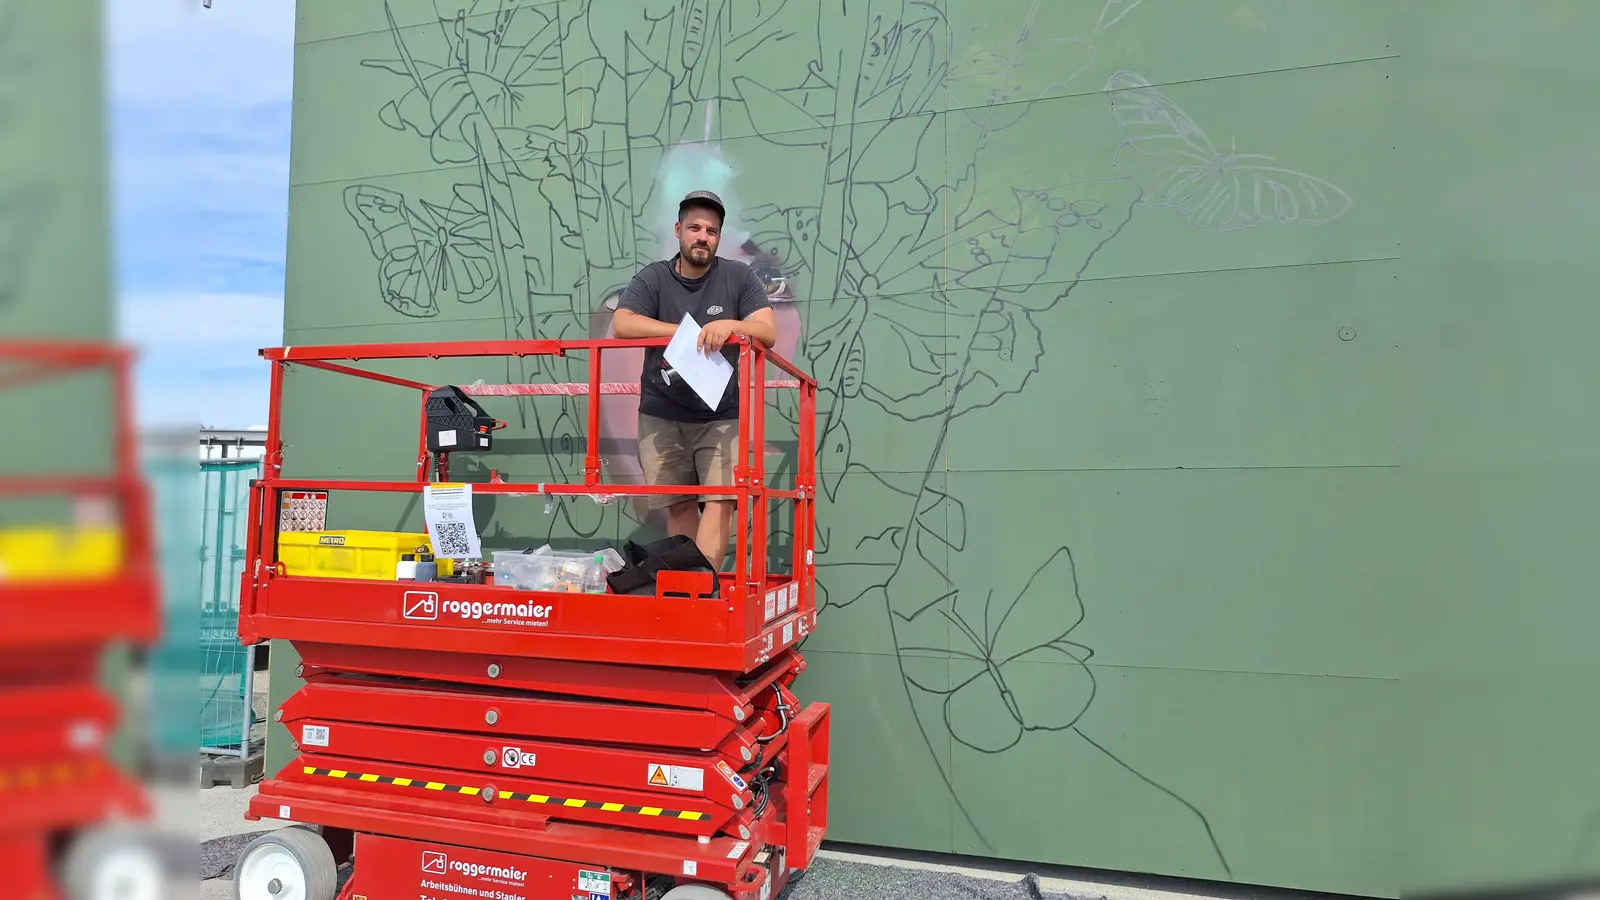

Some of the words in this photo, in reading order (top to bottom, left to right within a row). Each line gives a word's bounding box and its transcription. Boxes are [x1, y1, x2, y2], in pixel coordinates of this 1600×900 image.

[320, 536, 345, 545] METRO
[442, 600, 552, 618] roggermaier
[503, 618, 525, 626] Service
[521, 754, 534, 764] CE
[450, 860, 527, 880] roggermaier
[420, 879, 478, 896] Arbeitsbühnen
[479, 889, 495, 899] und
